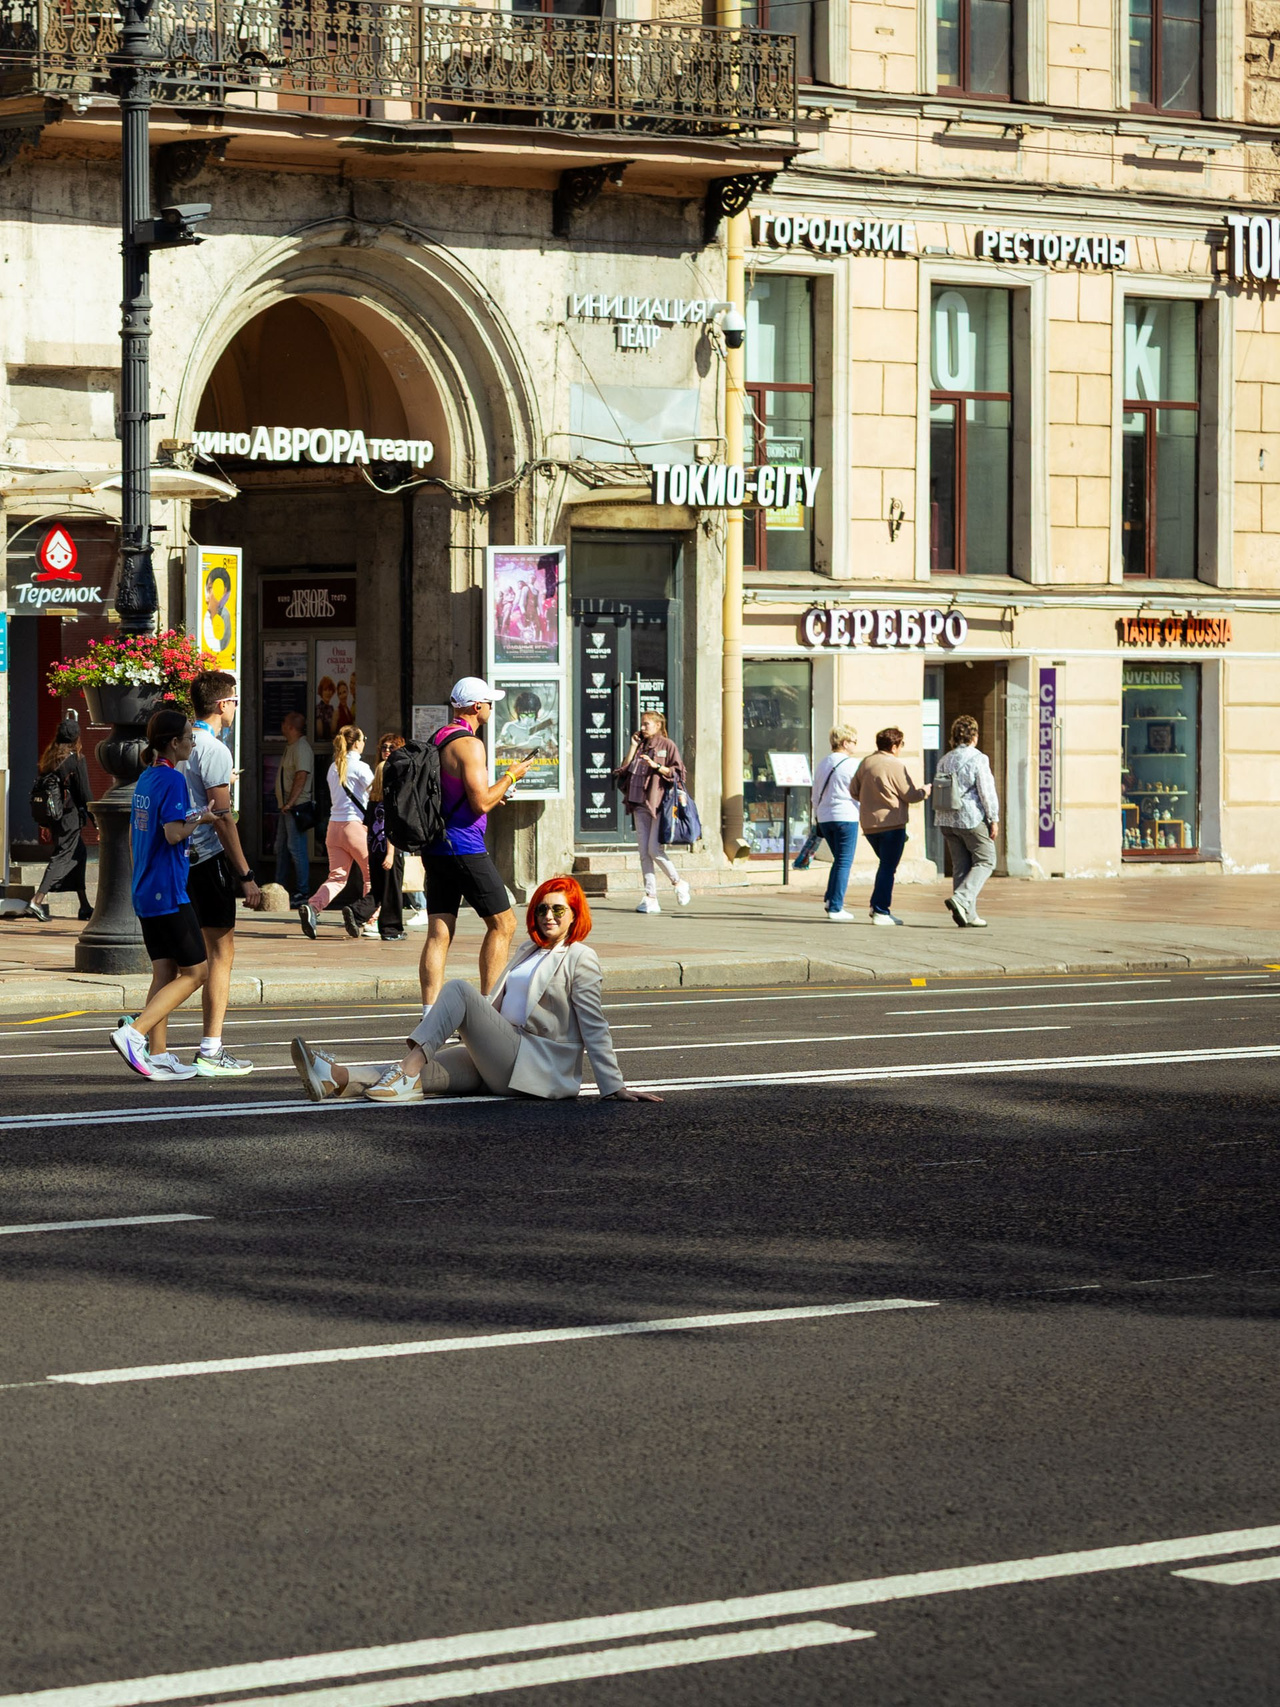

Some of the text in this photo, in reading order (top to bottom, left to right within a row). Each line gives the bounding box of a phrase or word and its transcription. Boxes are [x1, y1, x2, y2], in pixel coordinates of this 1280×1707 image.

[757, 214, 1131, 265] ГОРОДСКИЕ РЕСТОРАНЫ
[570, 293, 708, 323] ИНИЦИАЦИЯ
[618, 322, 661, 347] ТЕАТР
[192, 425, 434, 468] кино АВРОРА театр
[652, 463, 822, 508] ТОКИО-CITY
[15, 584, 102, 608] Теремок
[804, 608, 968, 647] СЕРЕБРО
[1122, 618, 1232, 644] TASTE OF RUSSIA
[1122, 671, 1180, 684] OUVENIRS
[1039, 684, 1053, 832] СЕРЕБРО
